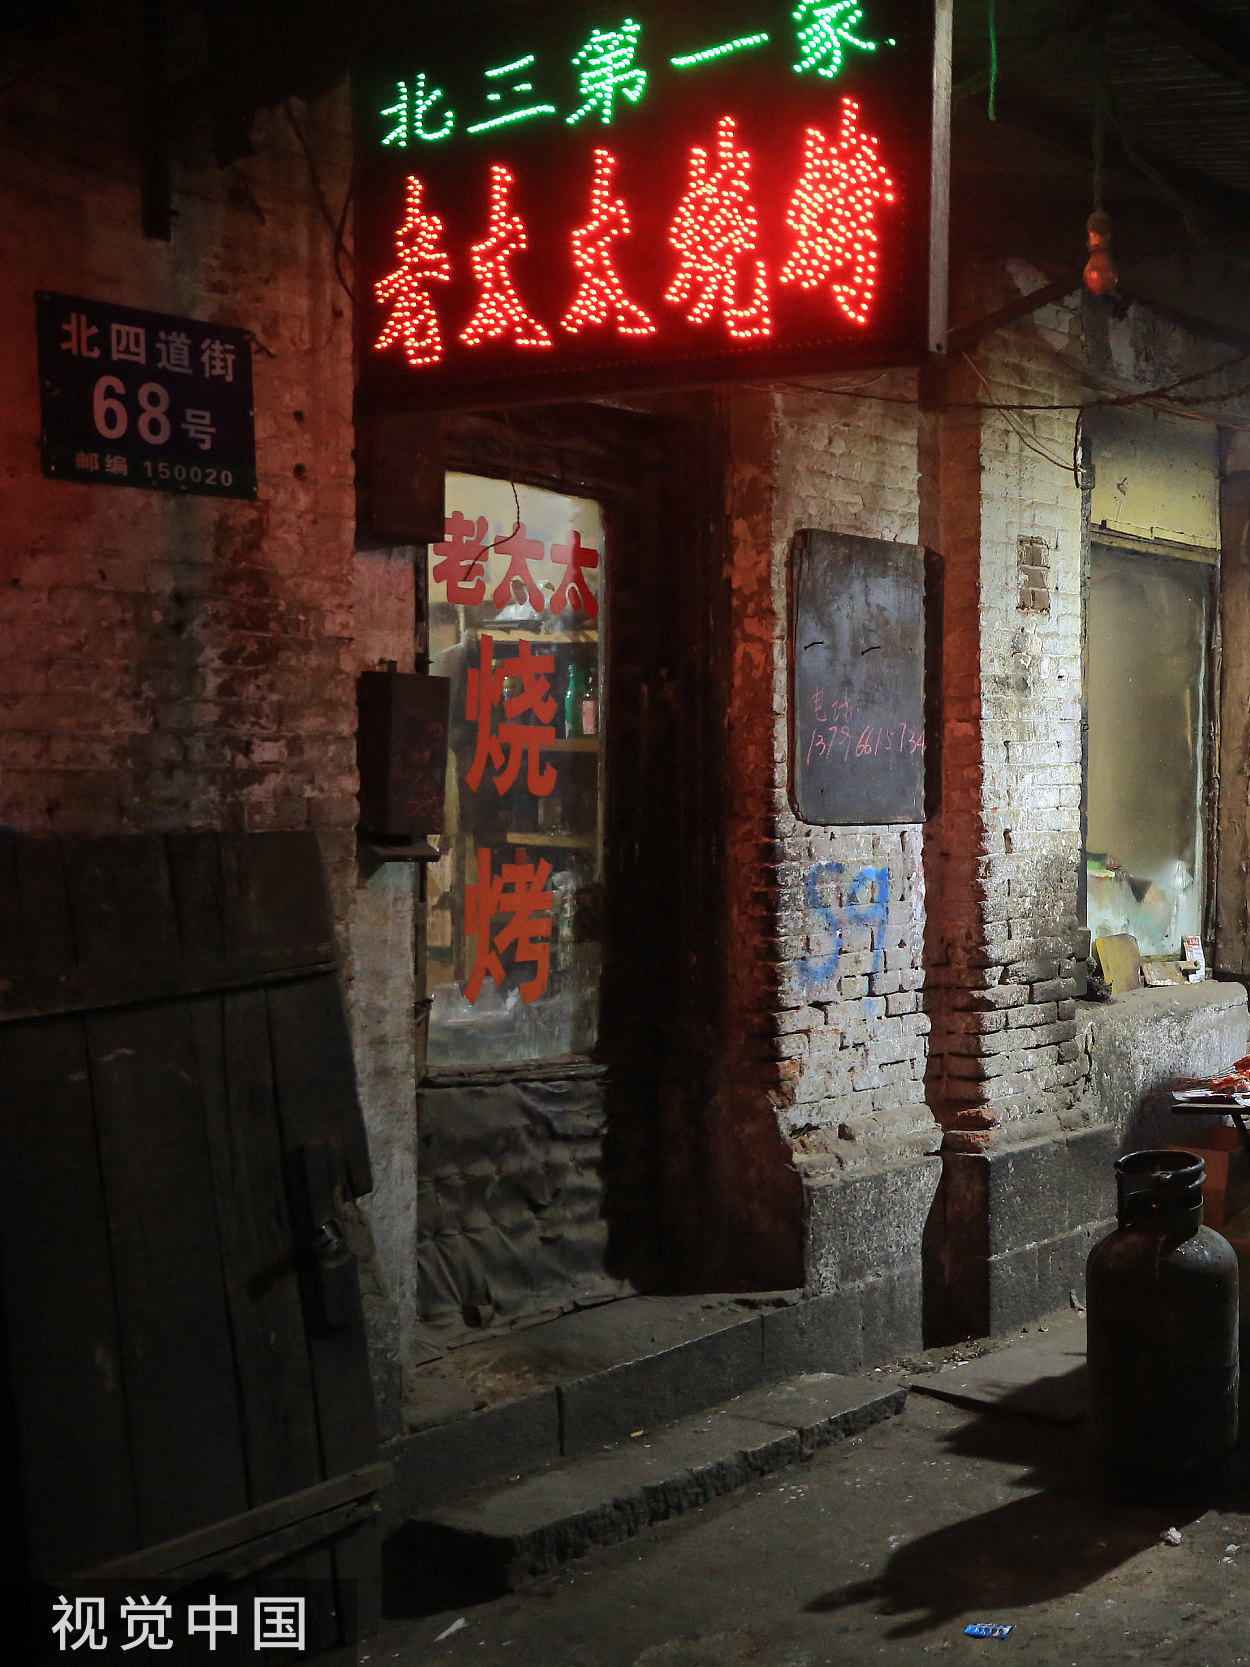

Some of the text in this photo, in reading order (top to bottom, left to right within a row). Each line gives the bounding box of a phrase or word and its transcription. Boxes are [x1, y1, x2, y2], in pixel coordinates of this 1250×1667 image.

[379, 0, 878, 147] 北三第一家
[374, 97, 895, 365] 老太太烧烤
[59, 312, 236, 383] 北四道街
[92, 374, 217, 451] 68号
[75, 451, 233, 487] 邮编 150020
[433, 511, 600, 619] 老太太
[465, 633, 558, 1006] 烧烤
